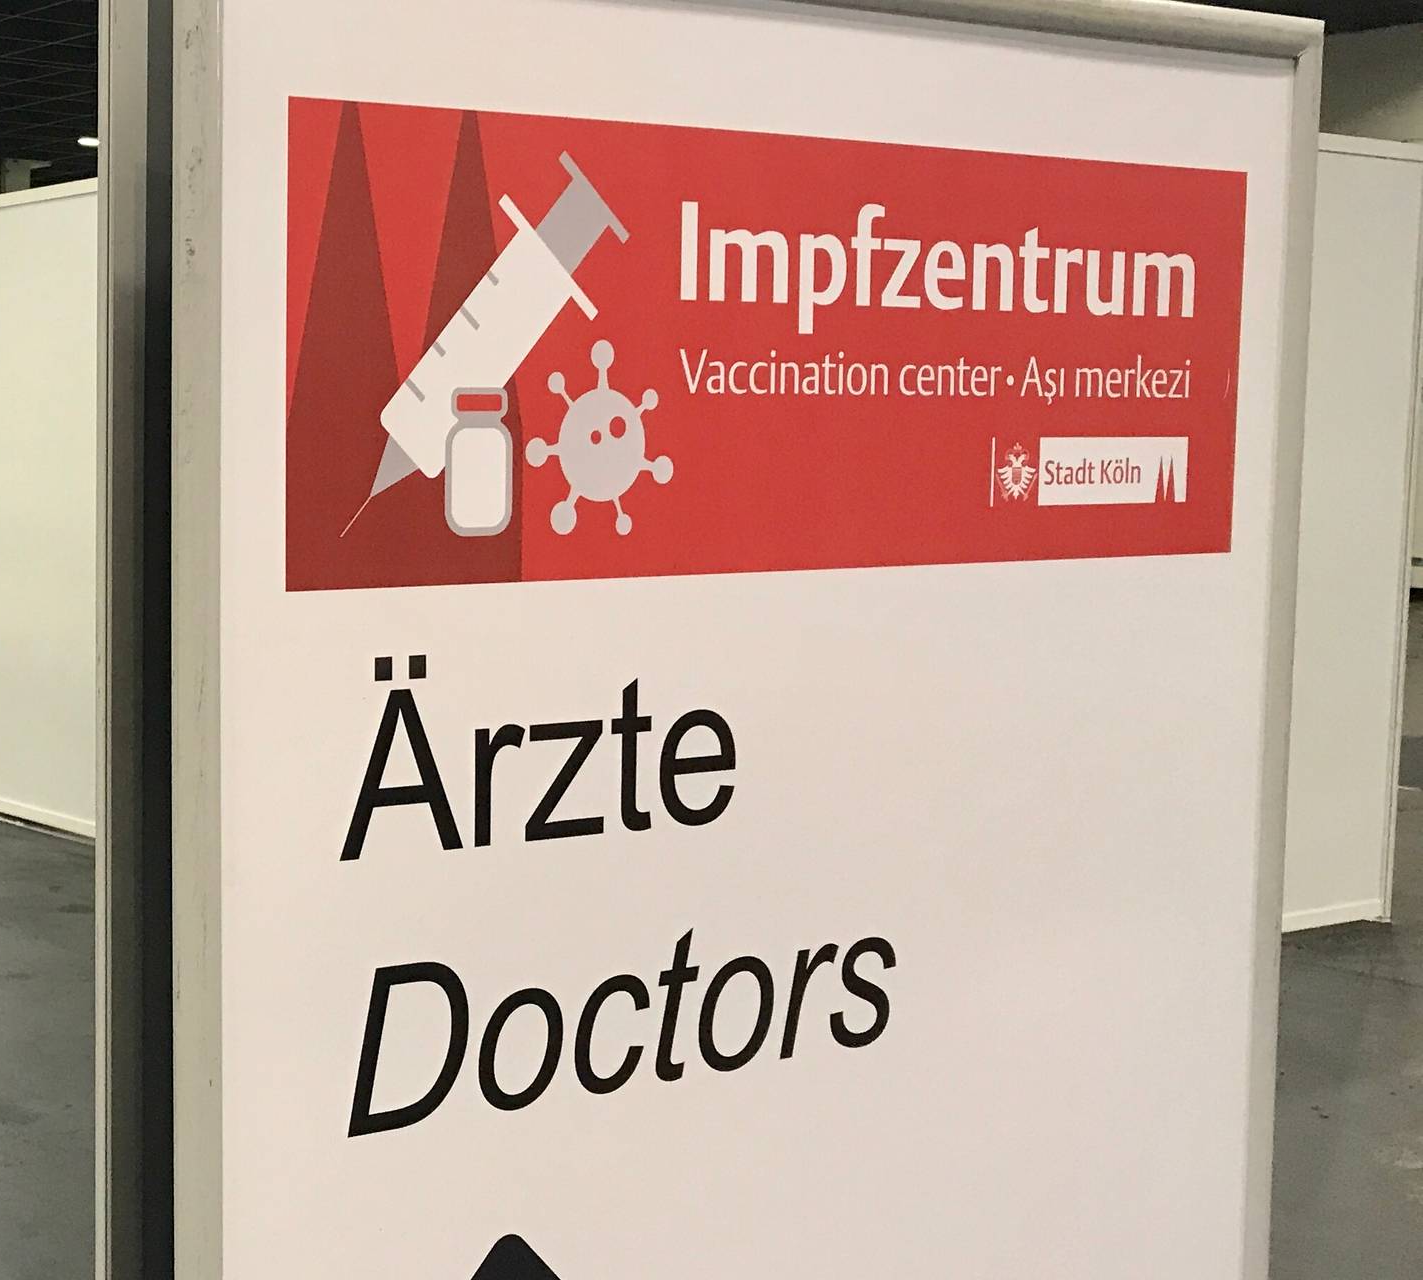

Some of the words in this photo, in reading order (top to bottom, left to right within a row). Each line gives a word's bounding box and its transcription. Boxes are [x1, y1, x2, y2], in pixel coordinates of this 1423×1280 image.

[680, 200, 1195, 334] Impfzentrum
[679, 348, 889, 396] Vaccination
[1020, 356, 1065, 405] Aşı
[1075, 355, 1191, 399] merkezi
[1044, 458, 1095, 485] Stadt
[1100, 457, 1141, 484] Köln
[340, 654, 736, 861] Ärzte
[348, 928, 896, 1137] Doctors
